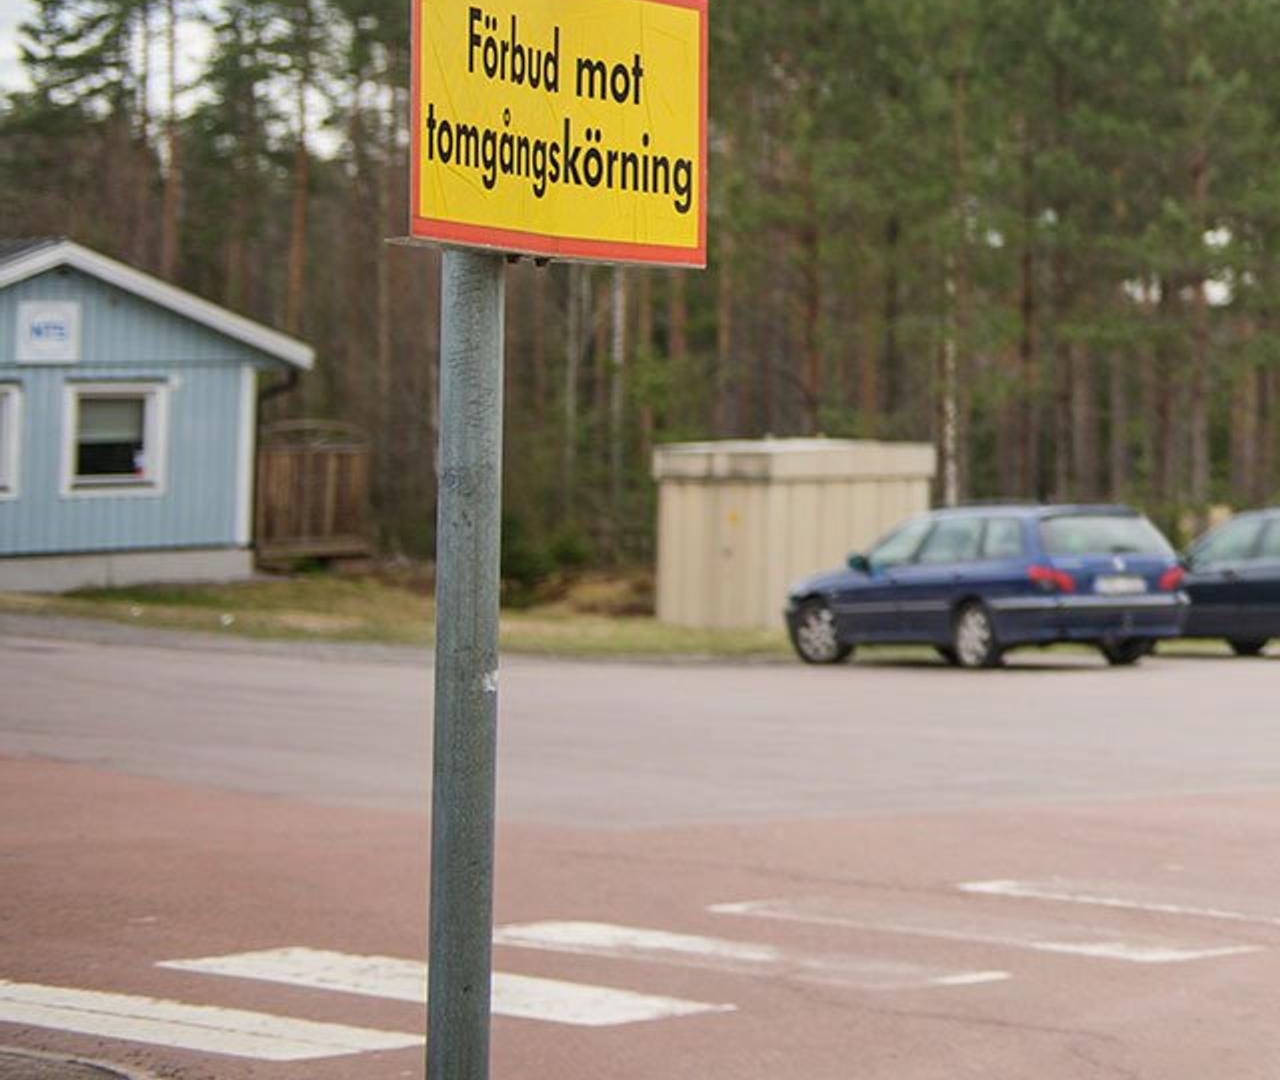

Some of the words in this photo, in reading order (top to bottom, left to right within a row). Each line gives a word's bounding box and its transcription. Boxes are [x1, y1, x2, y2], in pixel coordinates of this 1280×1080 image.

[468, 6, 560, 93] Förbud
[576, 54, 644, 105] mot
[427, 103, 693, 213] tomgångskörning
